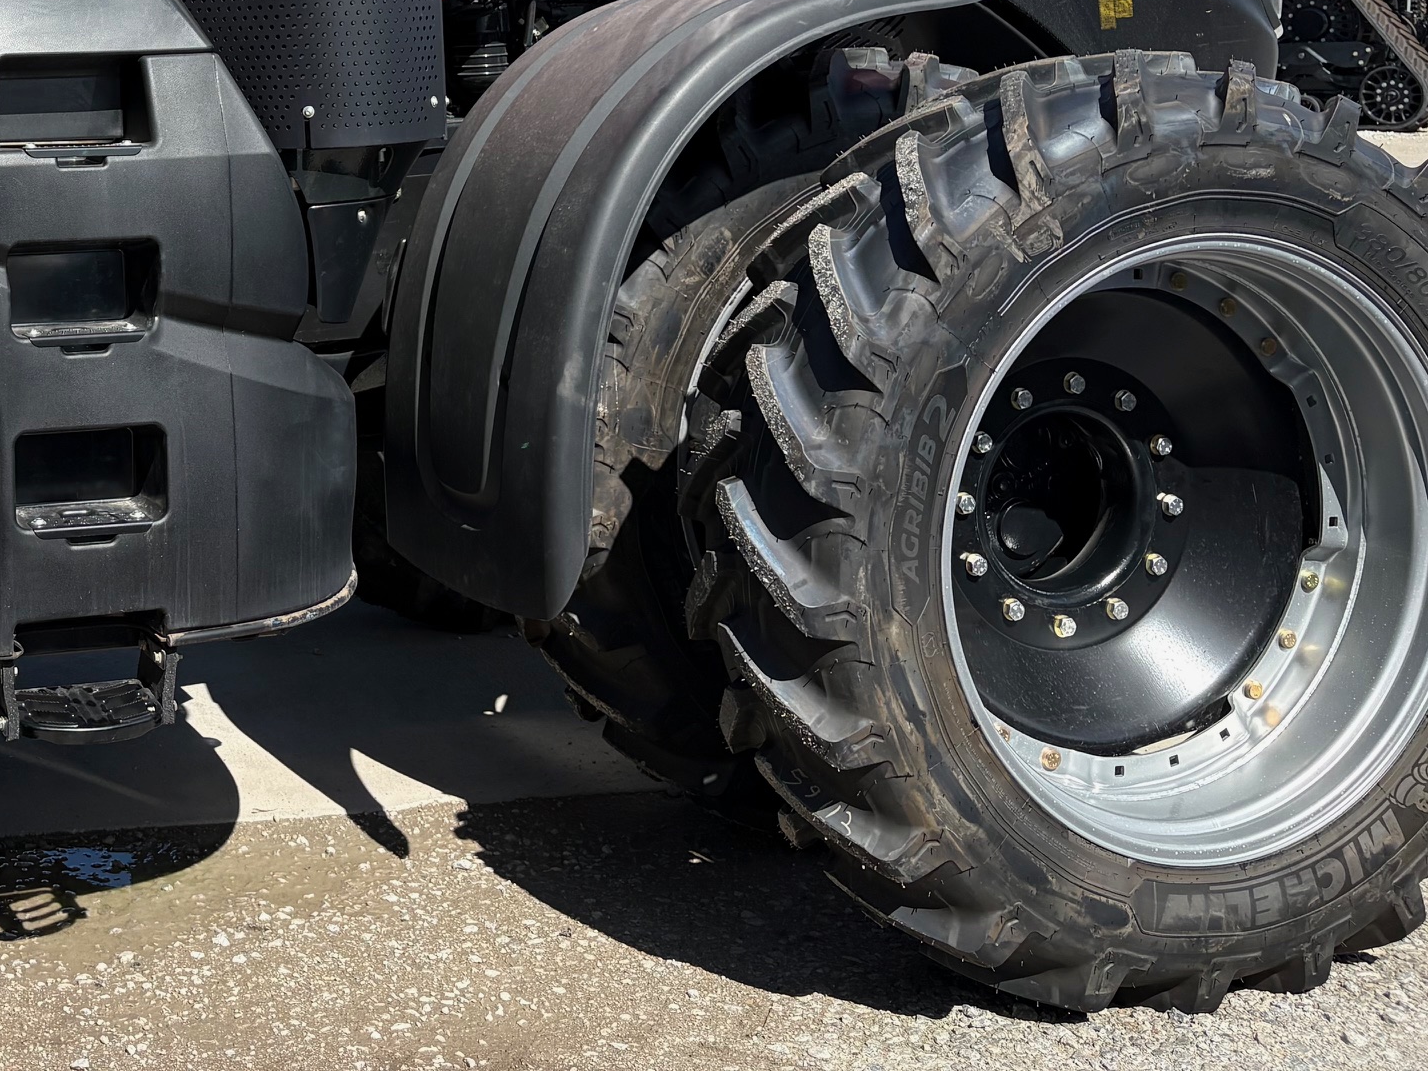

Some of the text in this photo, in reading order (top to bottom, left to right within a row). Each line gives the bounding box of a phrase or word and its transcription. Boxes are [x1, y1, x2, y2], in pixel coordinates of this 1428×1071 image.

[900, 393, 956, 584] AGRIBIB 2
[1158, 808, 1406, 930] MICHELIN
